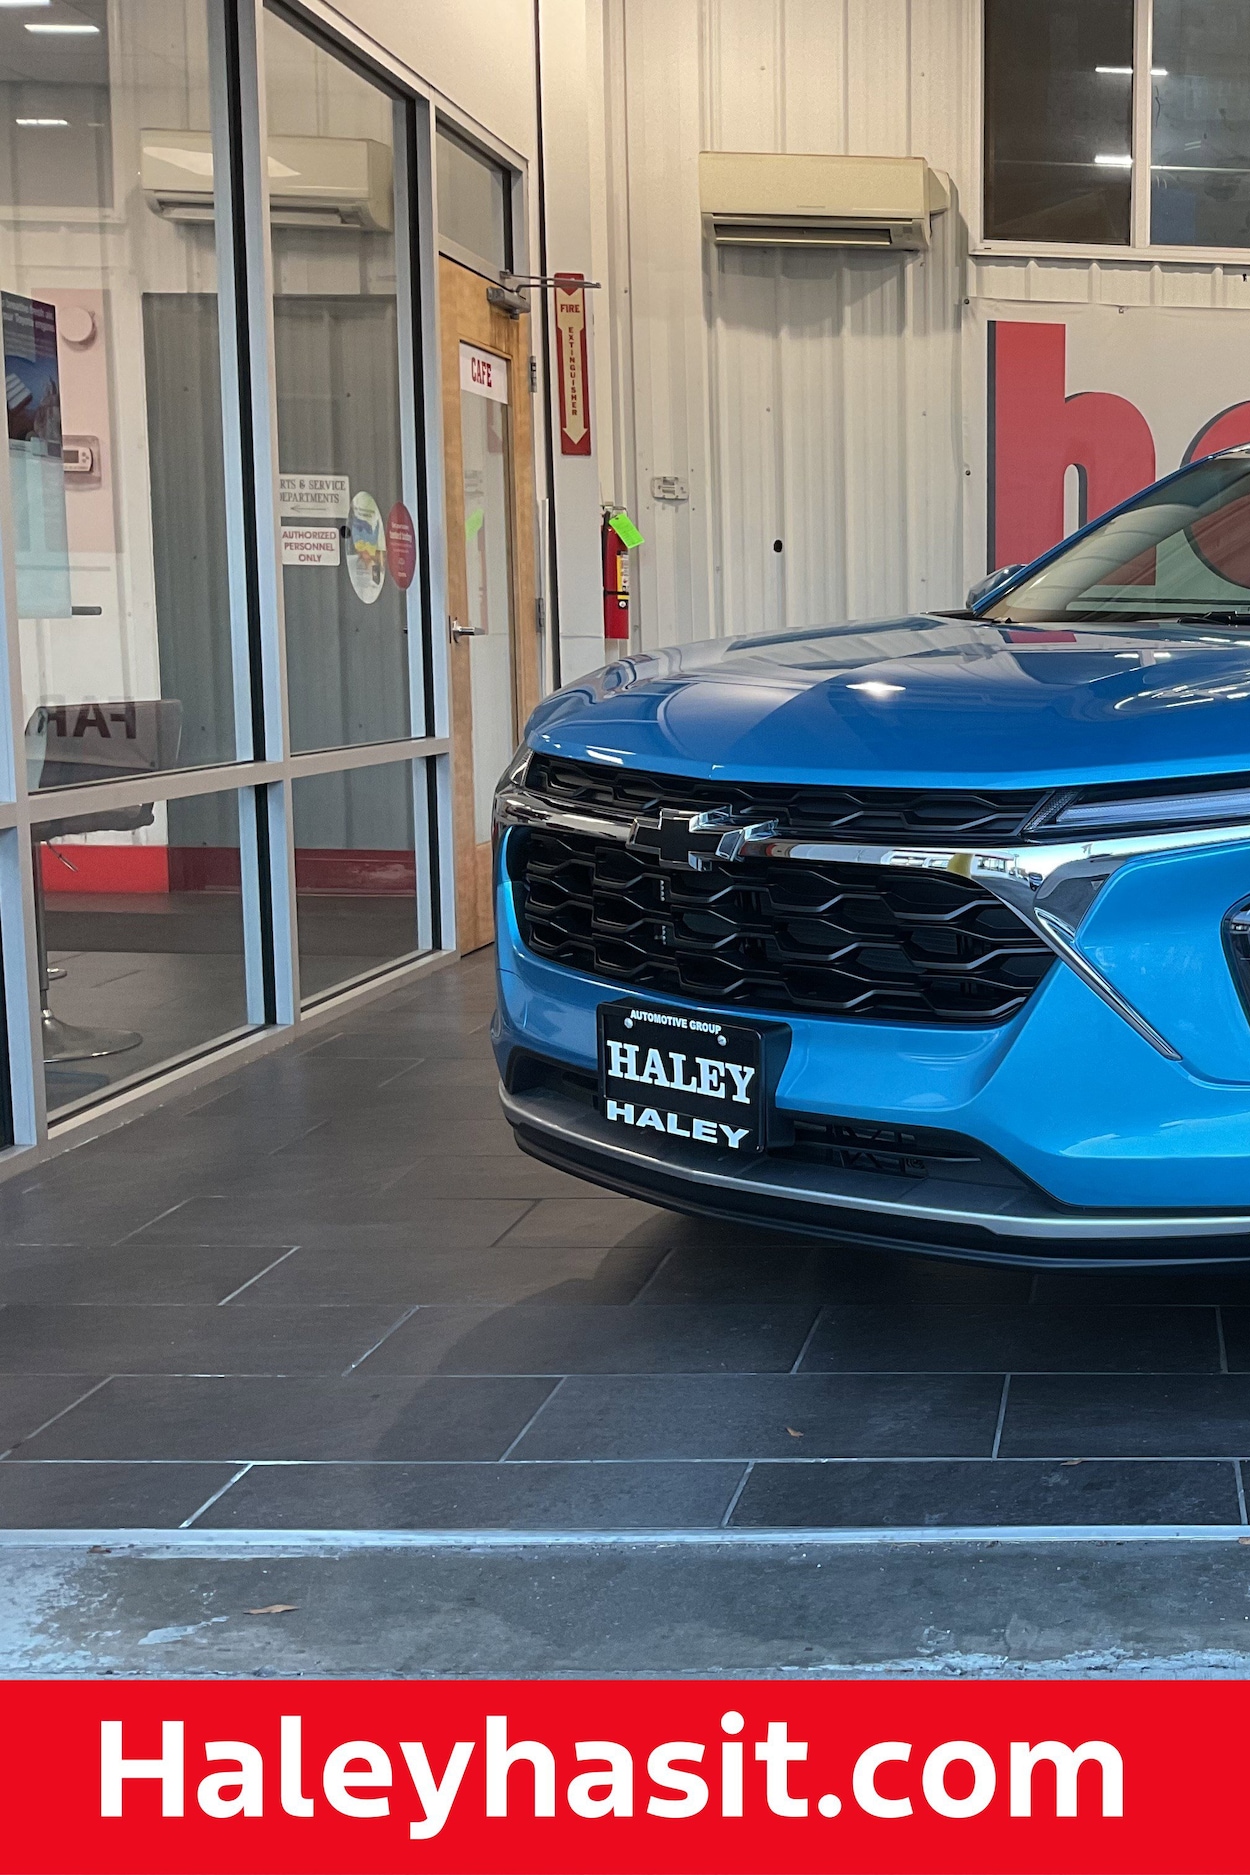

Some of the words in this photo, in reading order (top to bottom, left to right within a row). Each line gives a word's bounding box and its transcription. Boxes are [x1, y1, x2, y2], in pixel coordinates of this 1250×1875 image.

[560, 303, 581, 314] FIRE
[471, 356, 493, 388] CAFE
[567, 326, 578, 416] EXTINGUISHER
[299, 479, 306, 490] &
[308, 480, 346, 491] SERVICE
[282, 530, 337, 540] AUTHORIZED
[284, 542, 335, 551] PERSONNEL
[298, 554, 322, 563] ONLY
[630, 1010, 688, 1029] AUTOMOTIVE
[689, 1020, 722, 1035] GROUP
[607, 1040, 755, 1104] HALEY
[607, 1100, 749, 1149] HALEY
